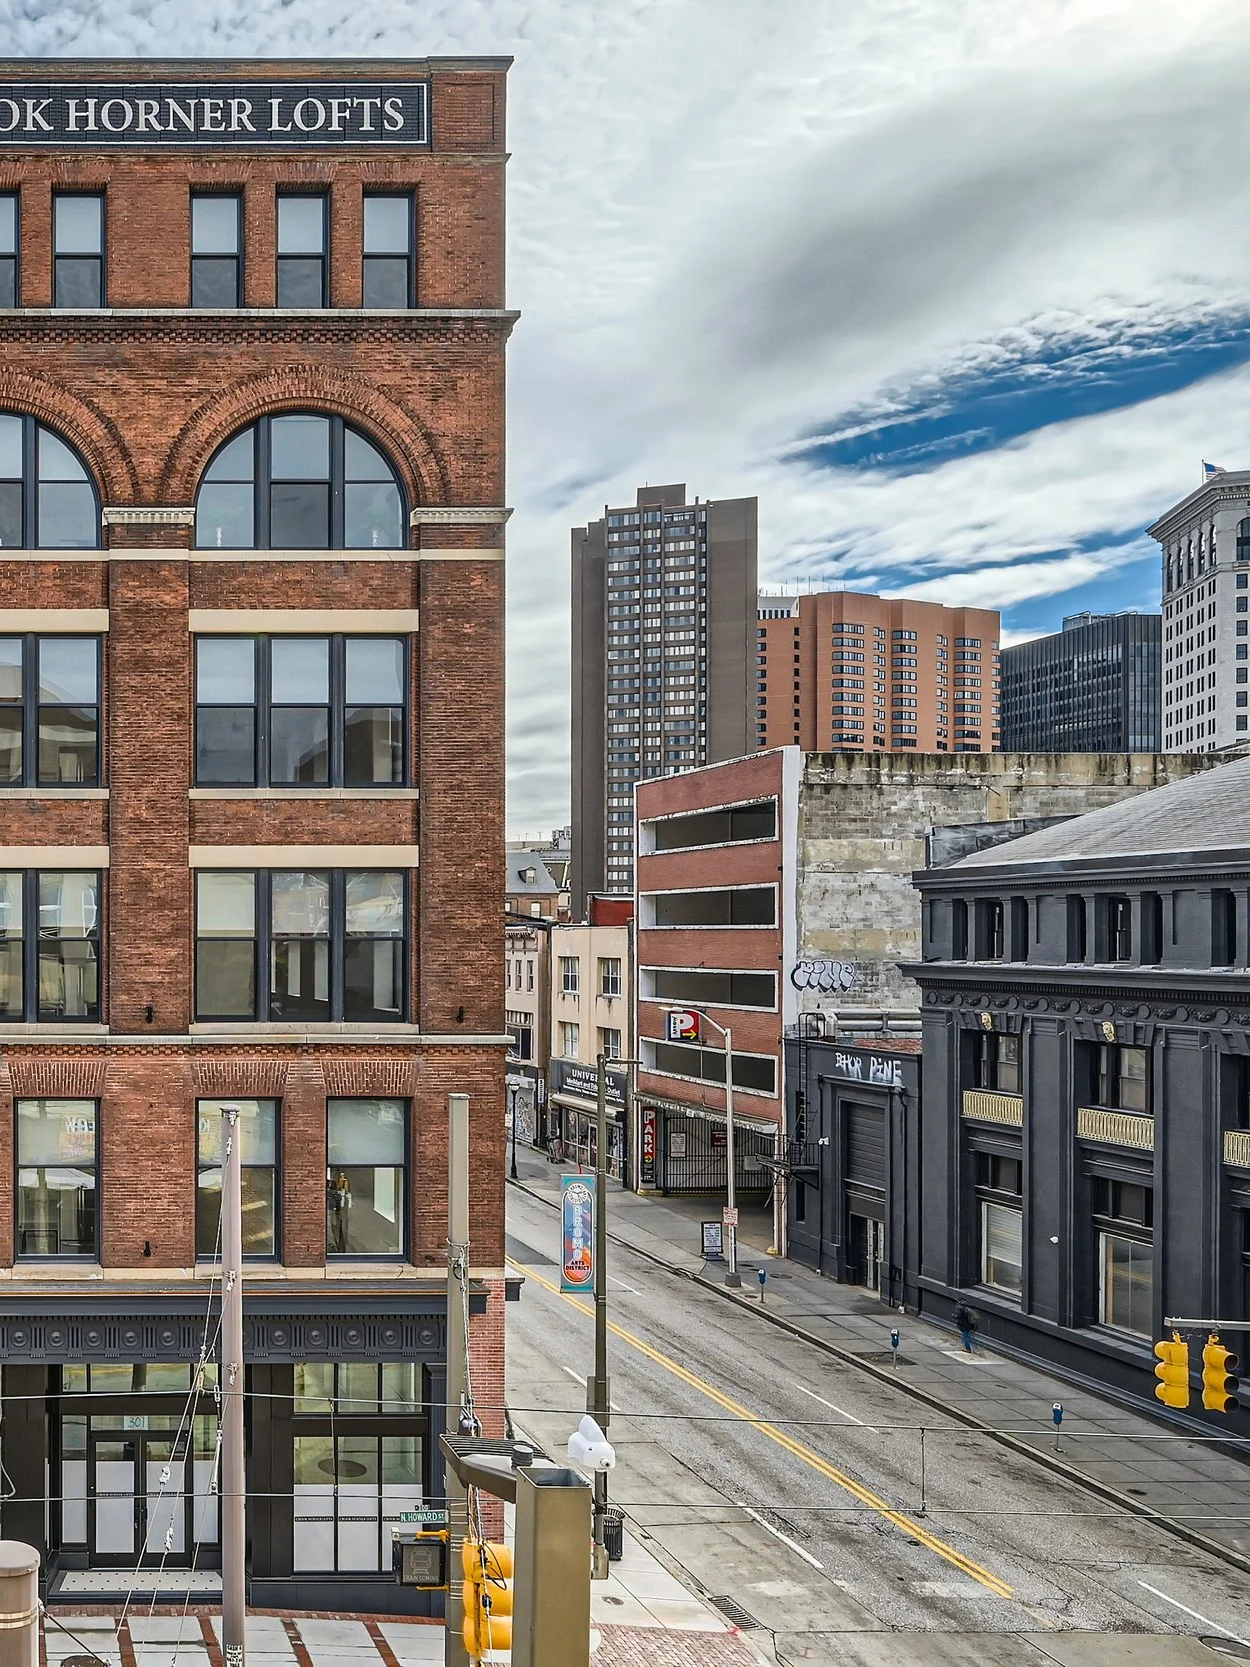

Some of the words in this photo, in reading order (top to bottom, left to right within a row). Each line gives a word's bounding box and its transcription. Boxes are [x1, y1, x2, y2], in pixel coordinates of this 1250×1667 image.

[65, 96, 256, 132] HORNER
[267, 96, 404, 132] LOFTS
[572, 1069, 615, 1086] UNIVEAL
[643, 1110, 656, 1153] PARK
[573, 1205, 584, 1260] BROMO
[127, 1416, 145, 1428] 301
[408, 1511, 438, 1522] HOWARD
